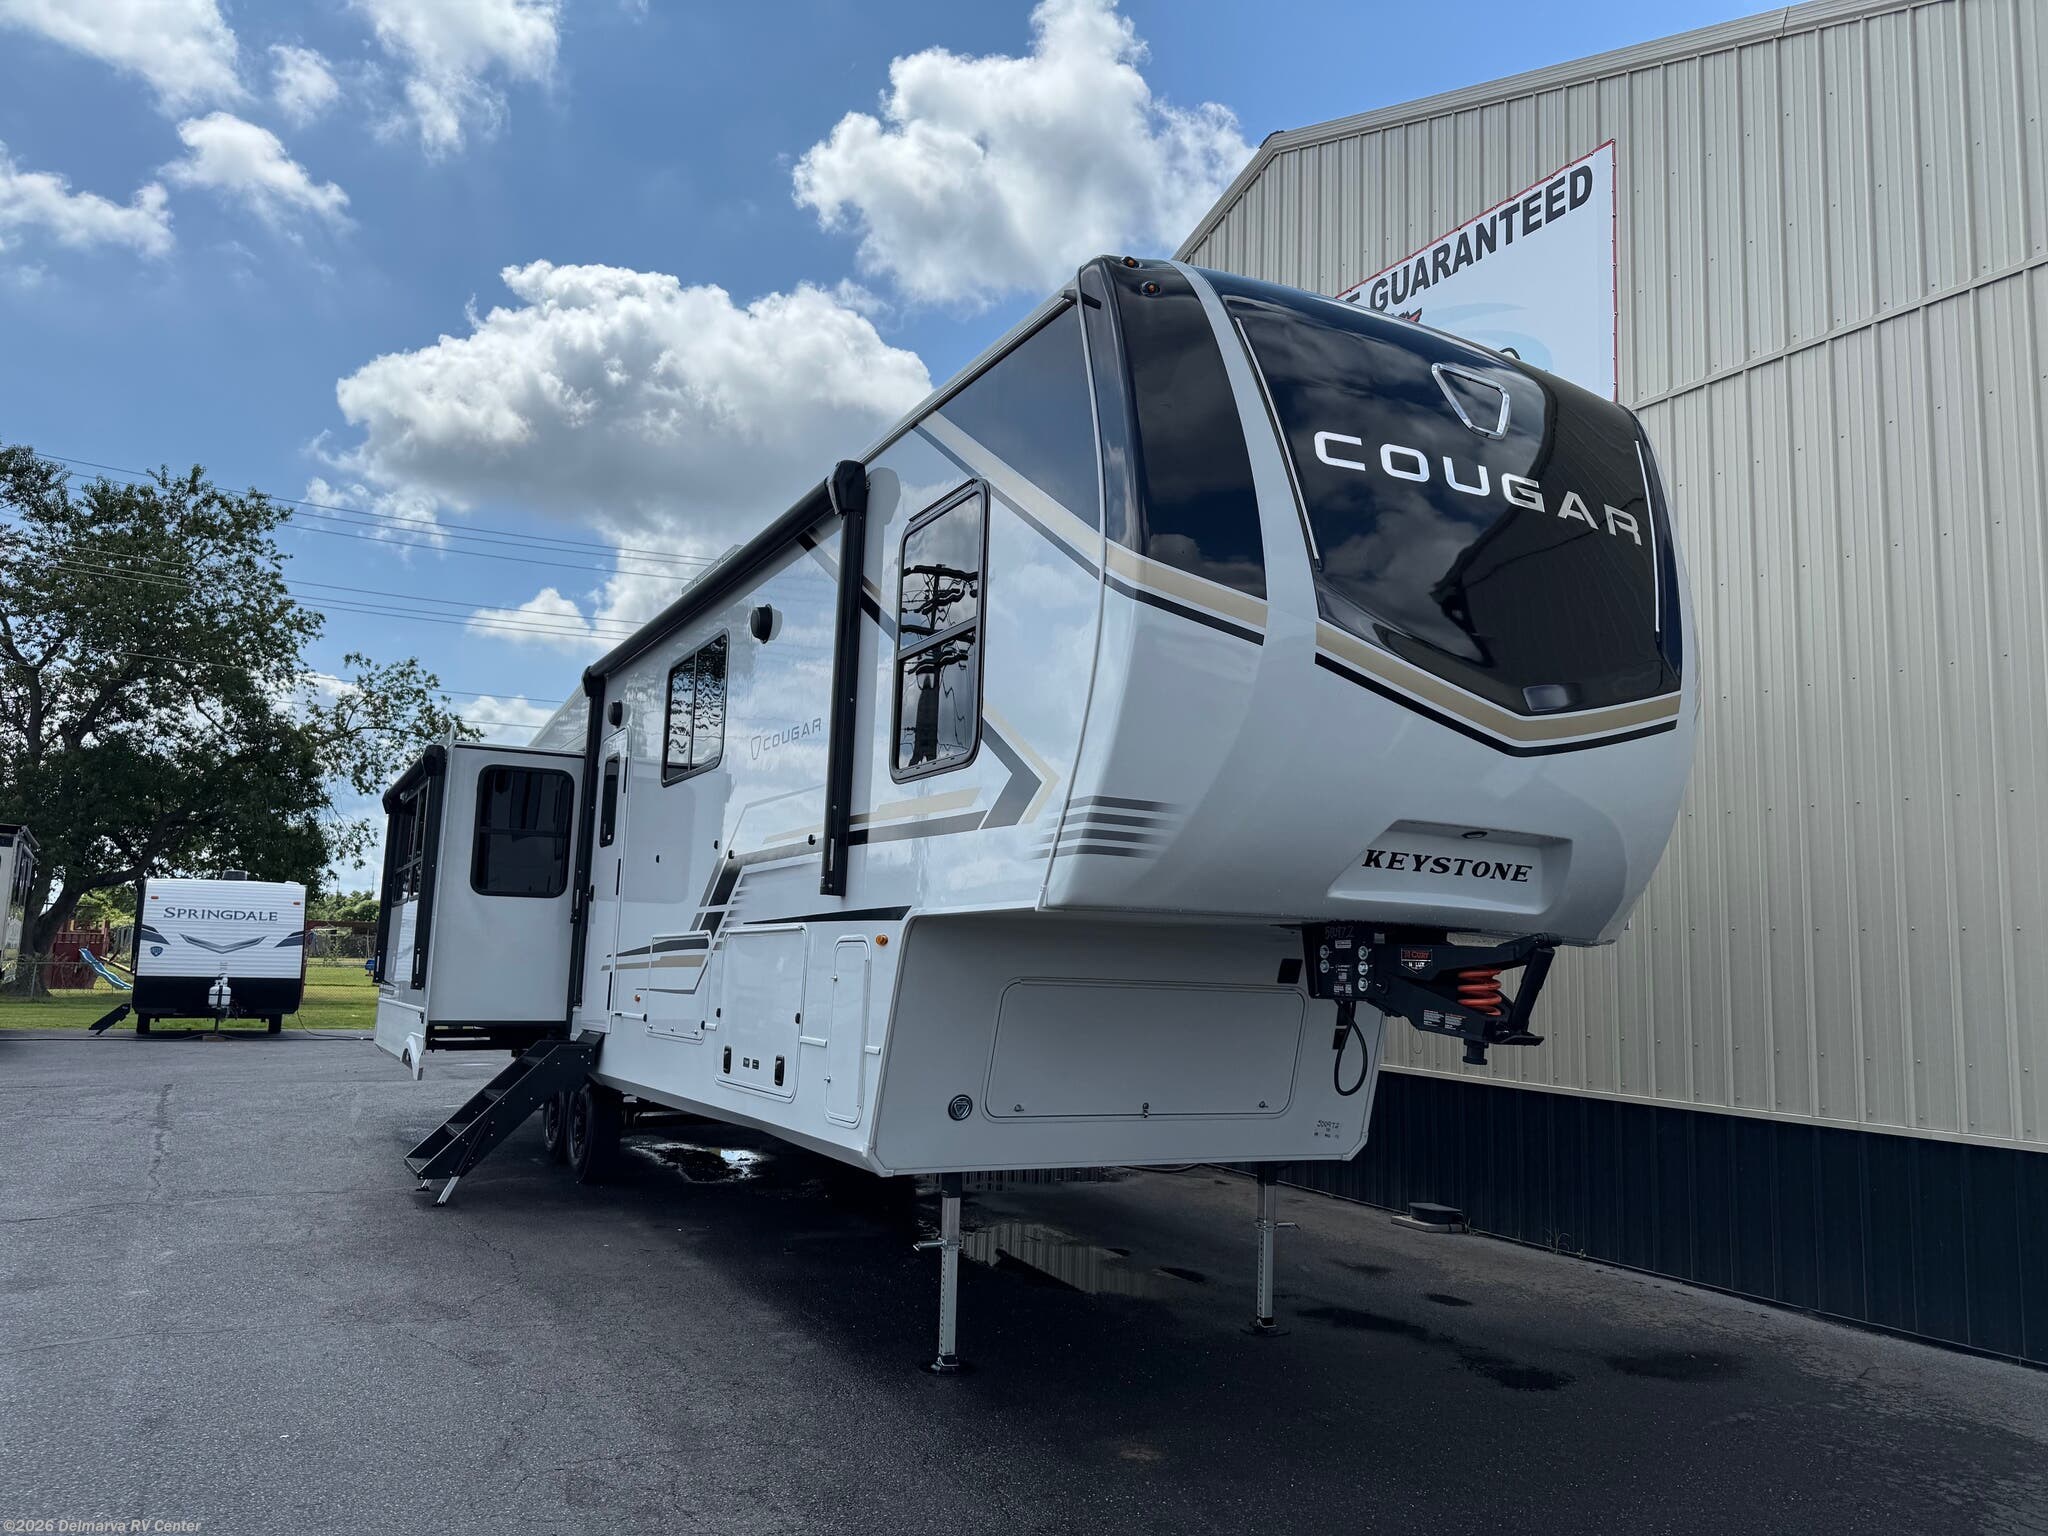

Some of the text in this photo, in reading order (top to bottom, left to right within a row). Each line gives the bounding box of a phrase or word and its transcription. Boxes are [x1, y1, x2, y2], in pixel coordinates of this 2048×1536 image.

[1370, 164, 1593, 312] GUARANTEED
[1314, 431, 1643, 546] COUGAR
[763, 717, 822, 751] COUGAR
[1361, 849, 1532, 883] KEYSTONE
[163, 907, 278, 922] SPRINGDALE
